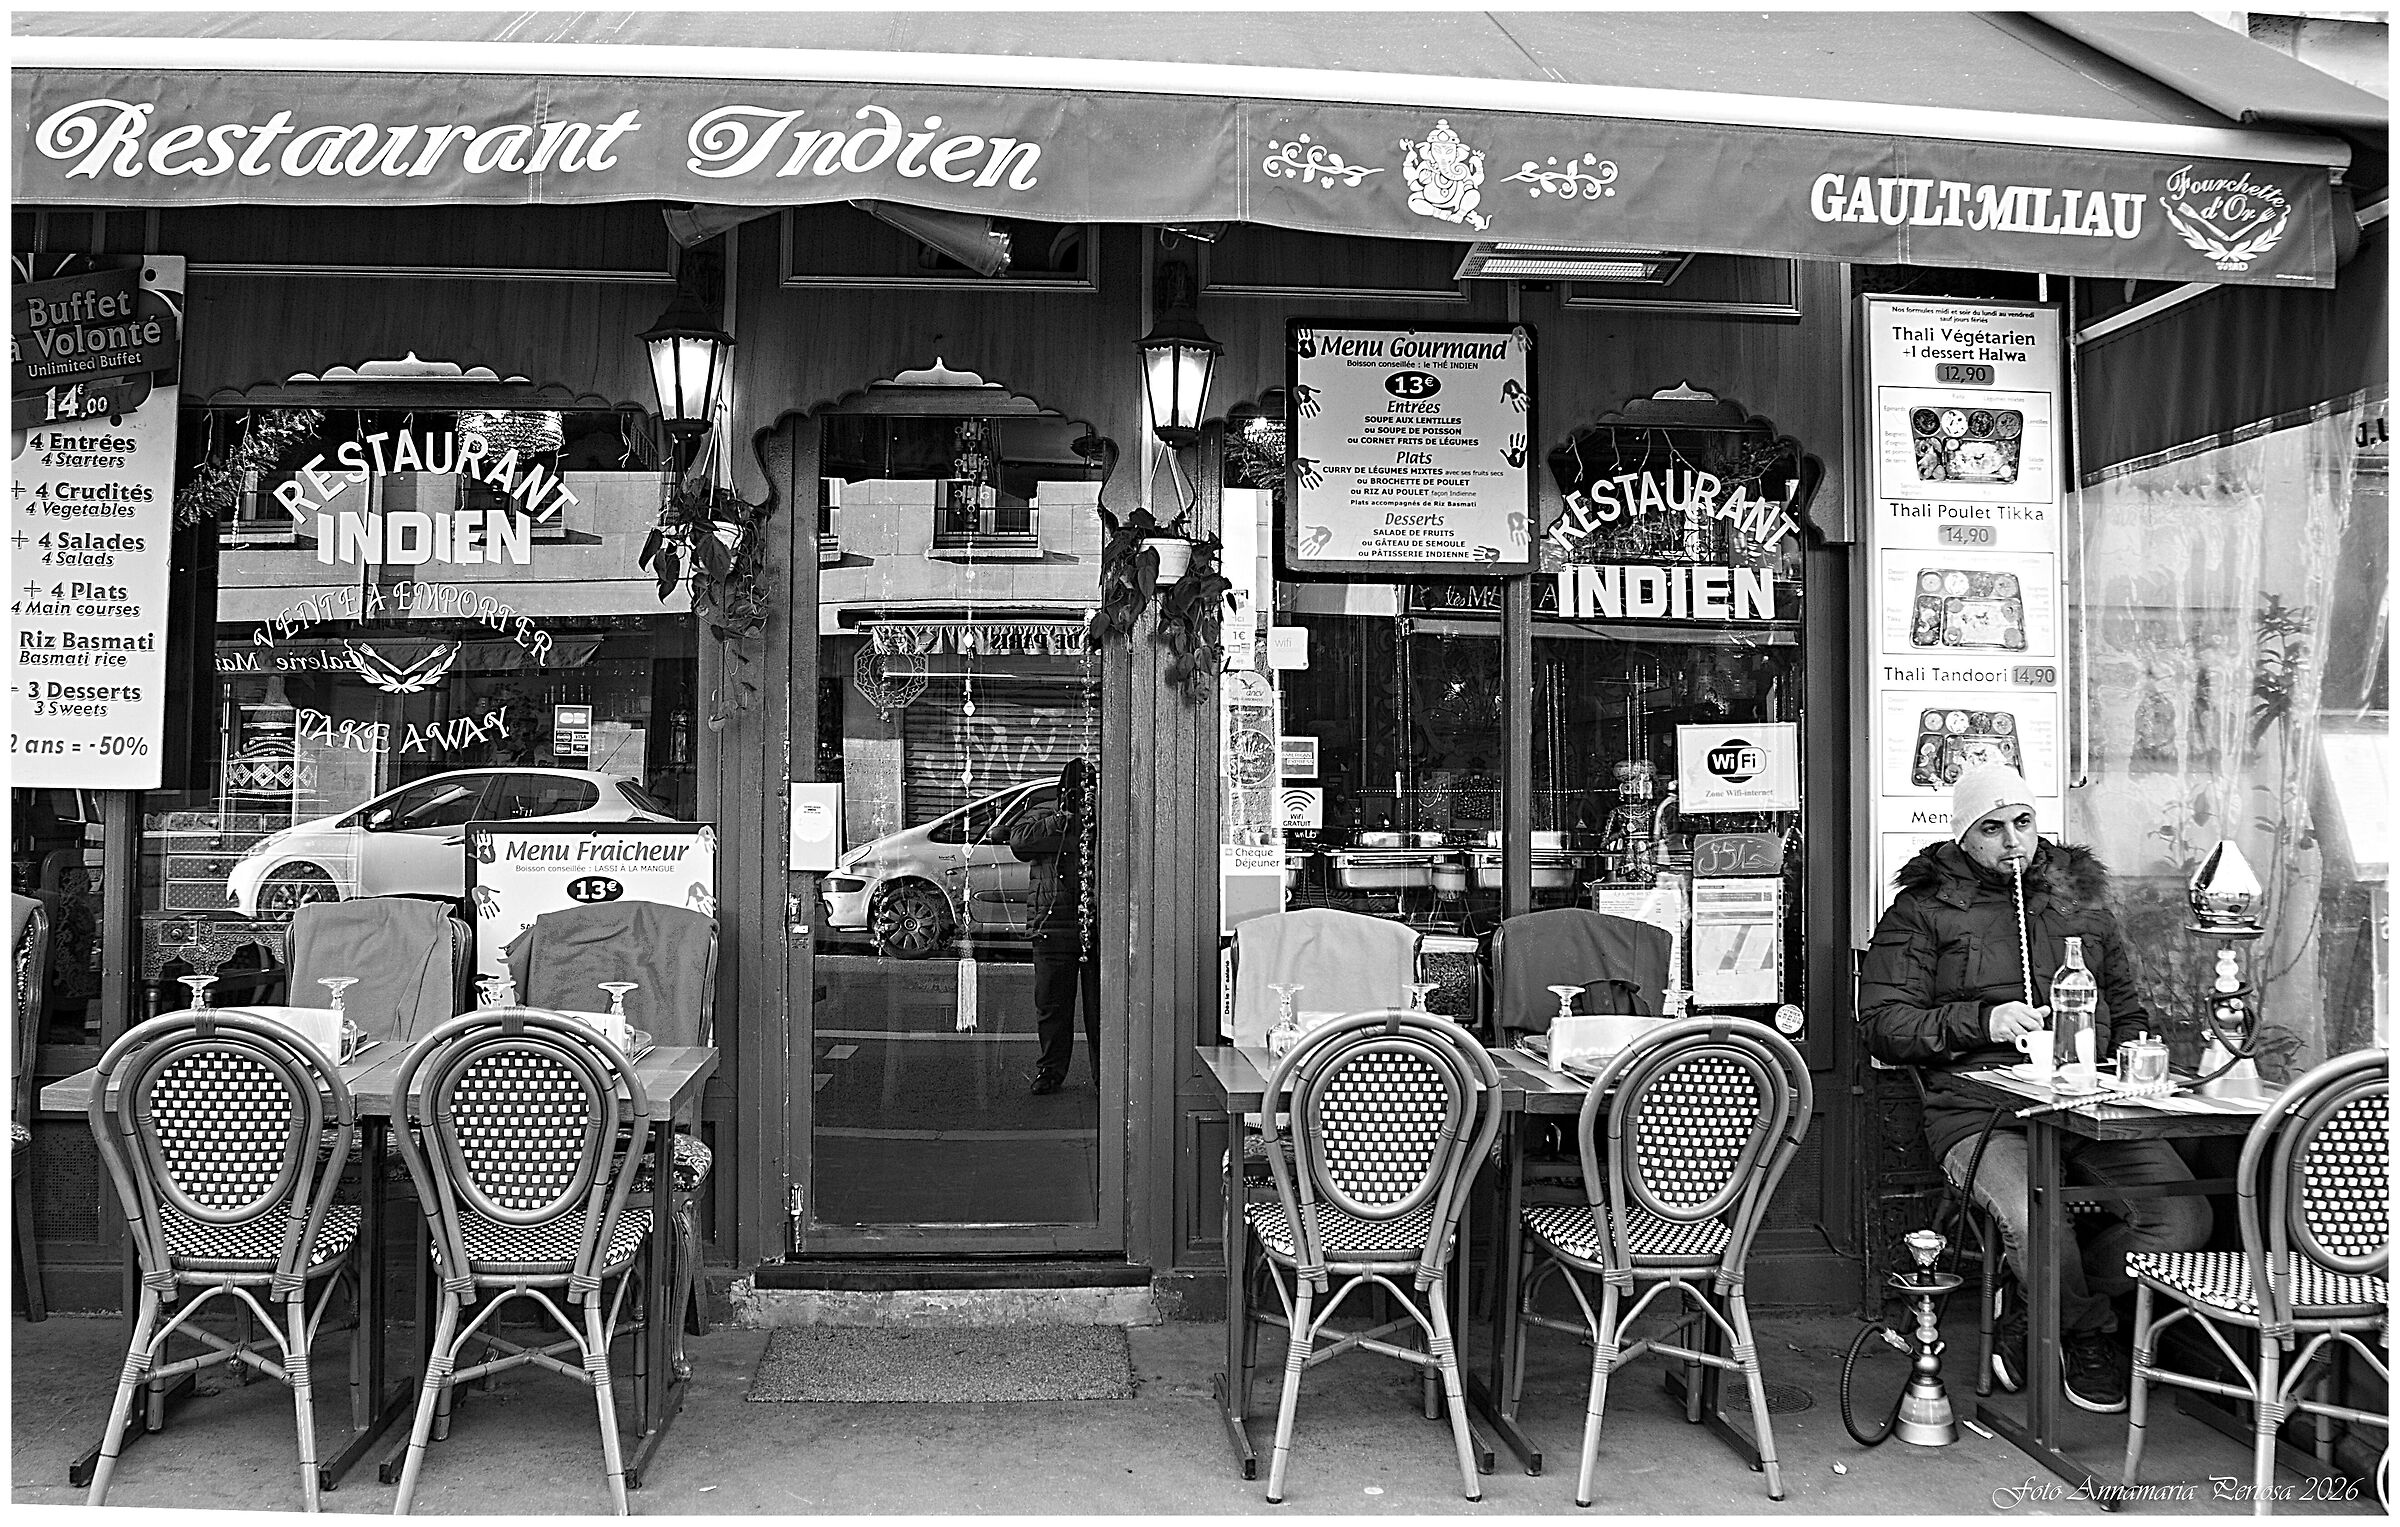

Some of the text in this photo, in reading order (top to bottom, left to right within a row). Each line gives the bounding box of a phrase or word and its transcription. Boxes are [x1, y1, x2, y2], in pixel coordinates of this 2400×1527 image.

[35, 99, 1041, 191] Restaurant Indien
[2166, 165, 2285, 208] Fourchette
[2201, 194, 2256, 221] d'Or
[27, 290, 131, 327] Buffet
[34, 316, 161, 358] Volonté
[1892, 326, 2036, 346] Thali Végétarien
[1321, 336, 1508, 360] Menu Gourmand
[1921, 347, 1974, 359] dessert
[1979, 349, 2027, 362] Halwa
[28, 353, 141, 377] Unlimited Buffet
[1433, 361, 1448, 369] THÉ
[1945, 366, 1986, 383] 12,90
[1395, 376, 1434, 394] 13€
[1388, 401, 1441, 414] Entrées
[1365, 416, 1393, 424] SOUPE
[1416, 417, 1461, 425] LENTILLES
[1423, 427, 1461, 435] POISSON
[30, 433, 136, 451] 4 Entrées
[1361, 437, 1395, 445] CORNET
[1397, 437, 1423, 445] FRITS
[1439, 437, 1479, 446] LÉGUMES
[42, 452, 125, 467] 4 Starters
[1397, 451, 1432, 464] Plats
[273, 429, 579, 525] RESTAURANT
[1323, 466, 1352, 474] CURRY
[1355, 466, 1366, 474] DE
[1368, 465, 1408, 475] LÉGUMES
[1423, 478, 1434, 486] DE
[1437, 478, 1470, 486] POULET
[35, 482, 153, 500] 4 Crudités
[1431, 490, 1447, 498] façon
[26, 502, 135, 517] 4 Vegetables
[1550, 469, 1800, 551] RESTAURANT
[1890, 503, 2044, 521] Thali Poulet Tikka
[1385, 513, 1444, 526] Desserts
[38, 532, 145, 550] 4 Salades
[317, 510, 532, 565] INDIEN
[1375, 538, 1409, 547] GÂTEAU
[1946, 528, 1989, 544] 14,90
[42, 552, 114, 566] 4 Salads
[1372, 548, 1423, 557] PÂTISSERIE
[1426, 550, 1469, 558] INDIENNE
[51, 583, 128, 600] 4 Plats
[1558, 566, 1775, 620] INDIEN
[26, 602, 70, 615] Main
[77, 603, 140, 617] courses
[253, 581, 553, 666] VENTE A EMPORTER
[19, 631, 154, 650] Riz Basmati
[1233, 631, 1245, 640] 1€
[1275, 639, 1291, 647] wifi
[19, 651, 127, 666] Basmati rice
[1884, 666, 2007, 682] Thali Tandoori
[2013, 669, 2055, 686] 14,90
[28, 682, 141, 700] 3 Desserts
[35, 701, 108, 716] 3 Sweets
[301, 708, 391, 753] TAKE
[25, 739, 64, 754] ans
[1712, 751, 1757, 770] WiFi
[1705, 788, 1773, 799] Zone Wifi-internet
[1912, 811, 1953, 823] Men
[506, 840, 689, 862] Menu Fraicheur
[548, 864, 586, 872] conseillée
[576, 880, 617, 899] 13€
